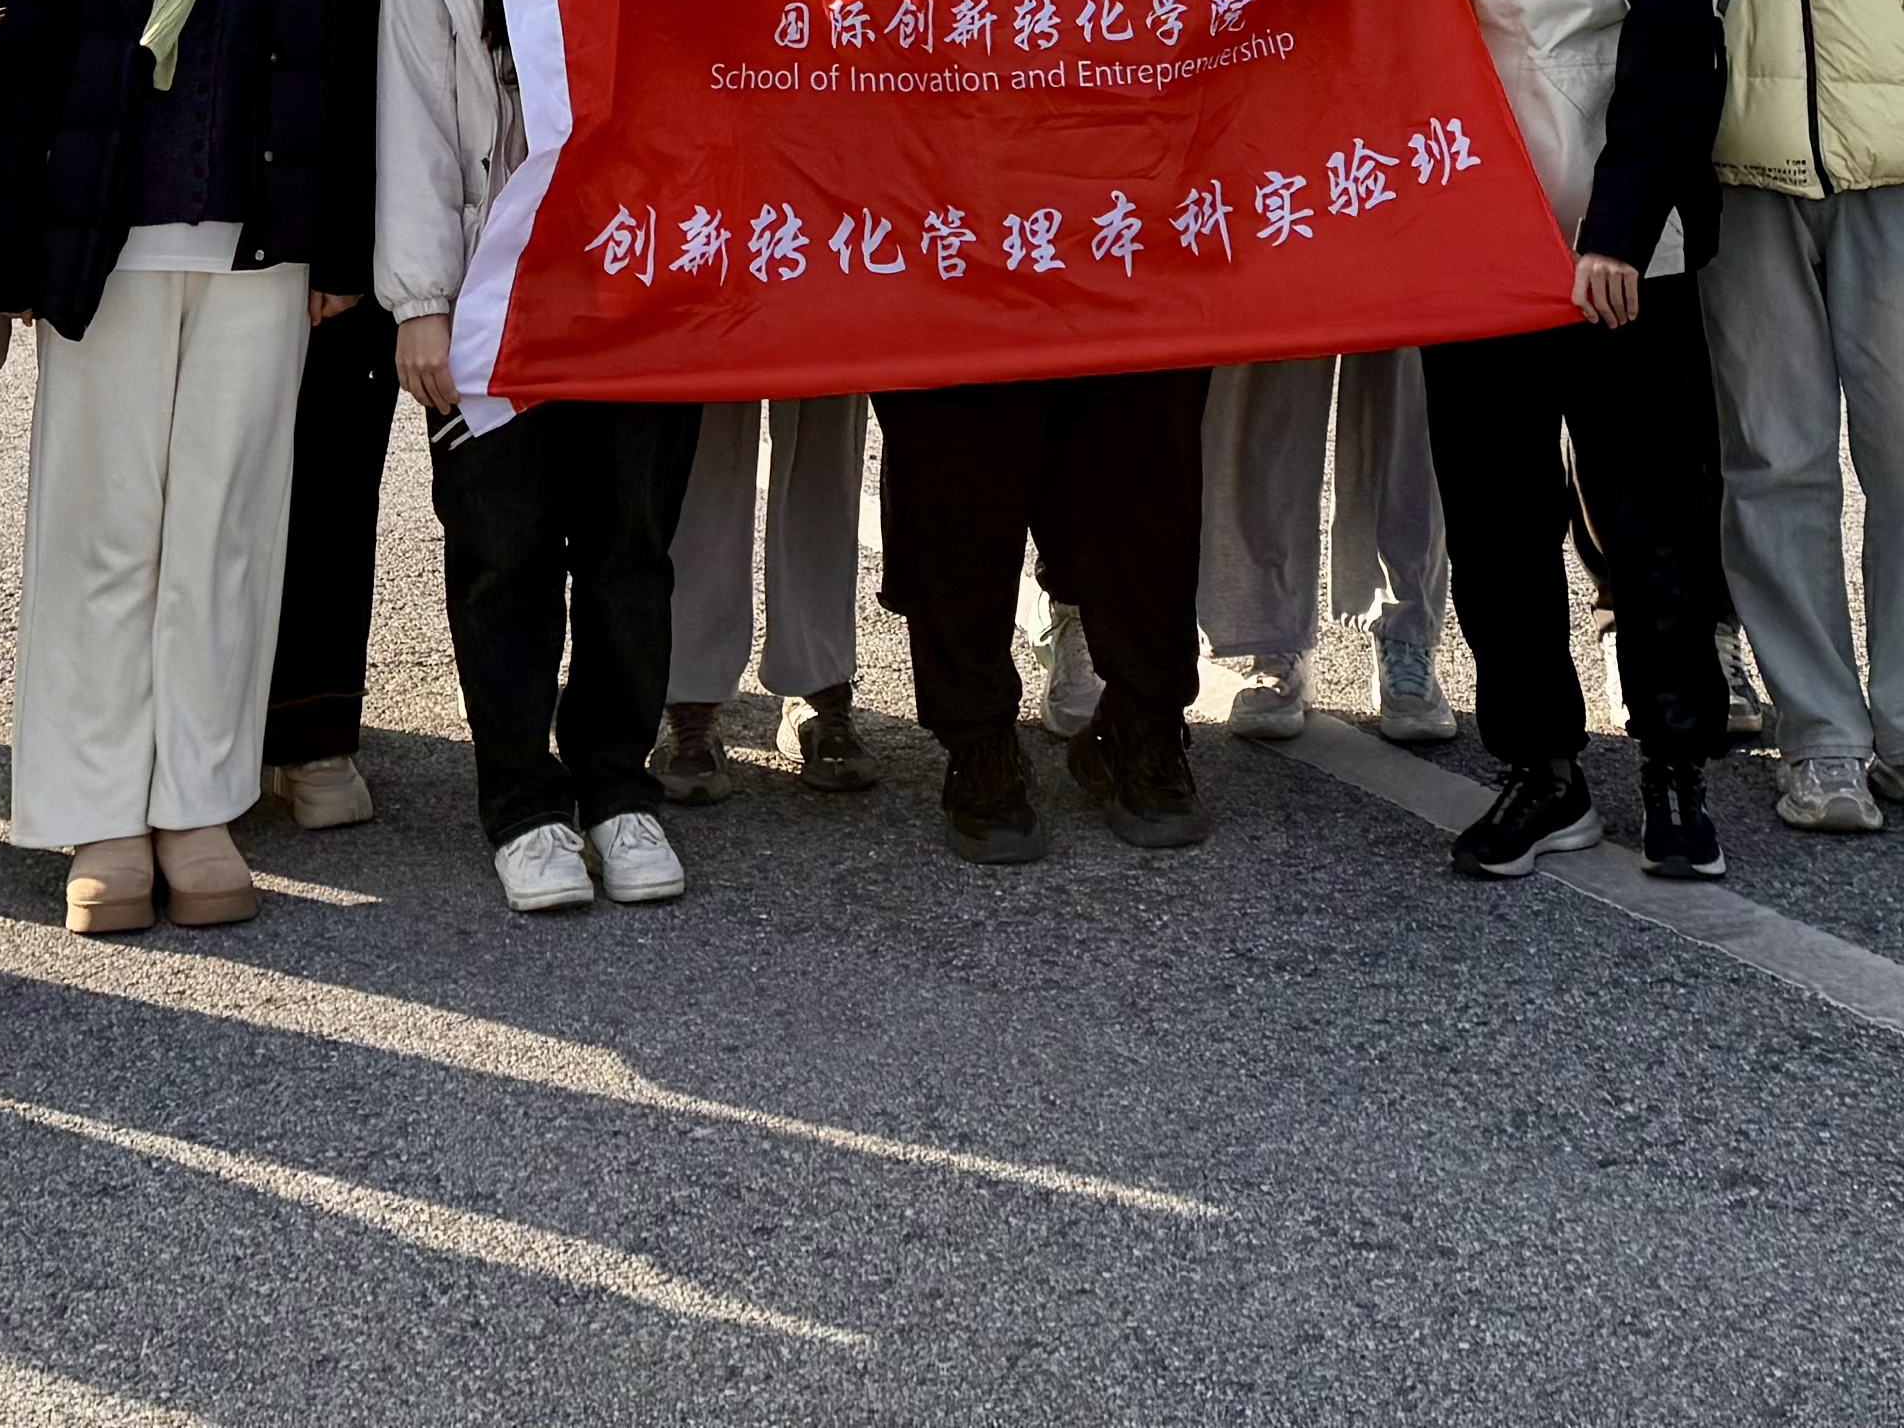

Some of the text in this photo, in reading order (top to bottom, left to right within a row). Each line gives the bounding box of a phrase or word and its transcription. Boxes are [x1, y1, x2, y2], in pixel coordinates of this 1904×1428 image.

[710, 63, 799, 90] School
[810, 62, 840, 91] of
[851, 63, 1000, 93] Innovation
[1011, 60, 1066, 90] and
[583, 117, 1483, 287] 创新转化管理本科实验班
